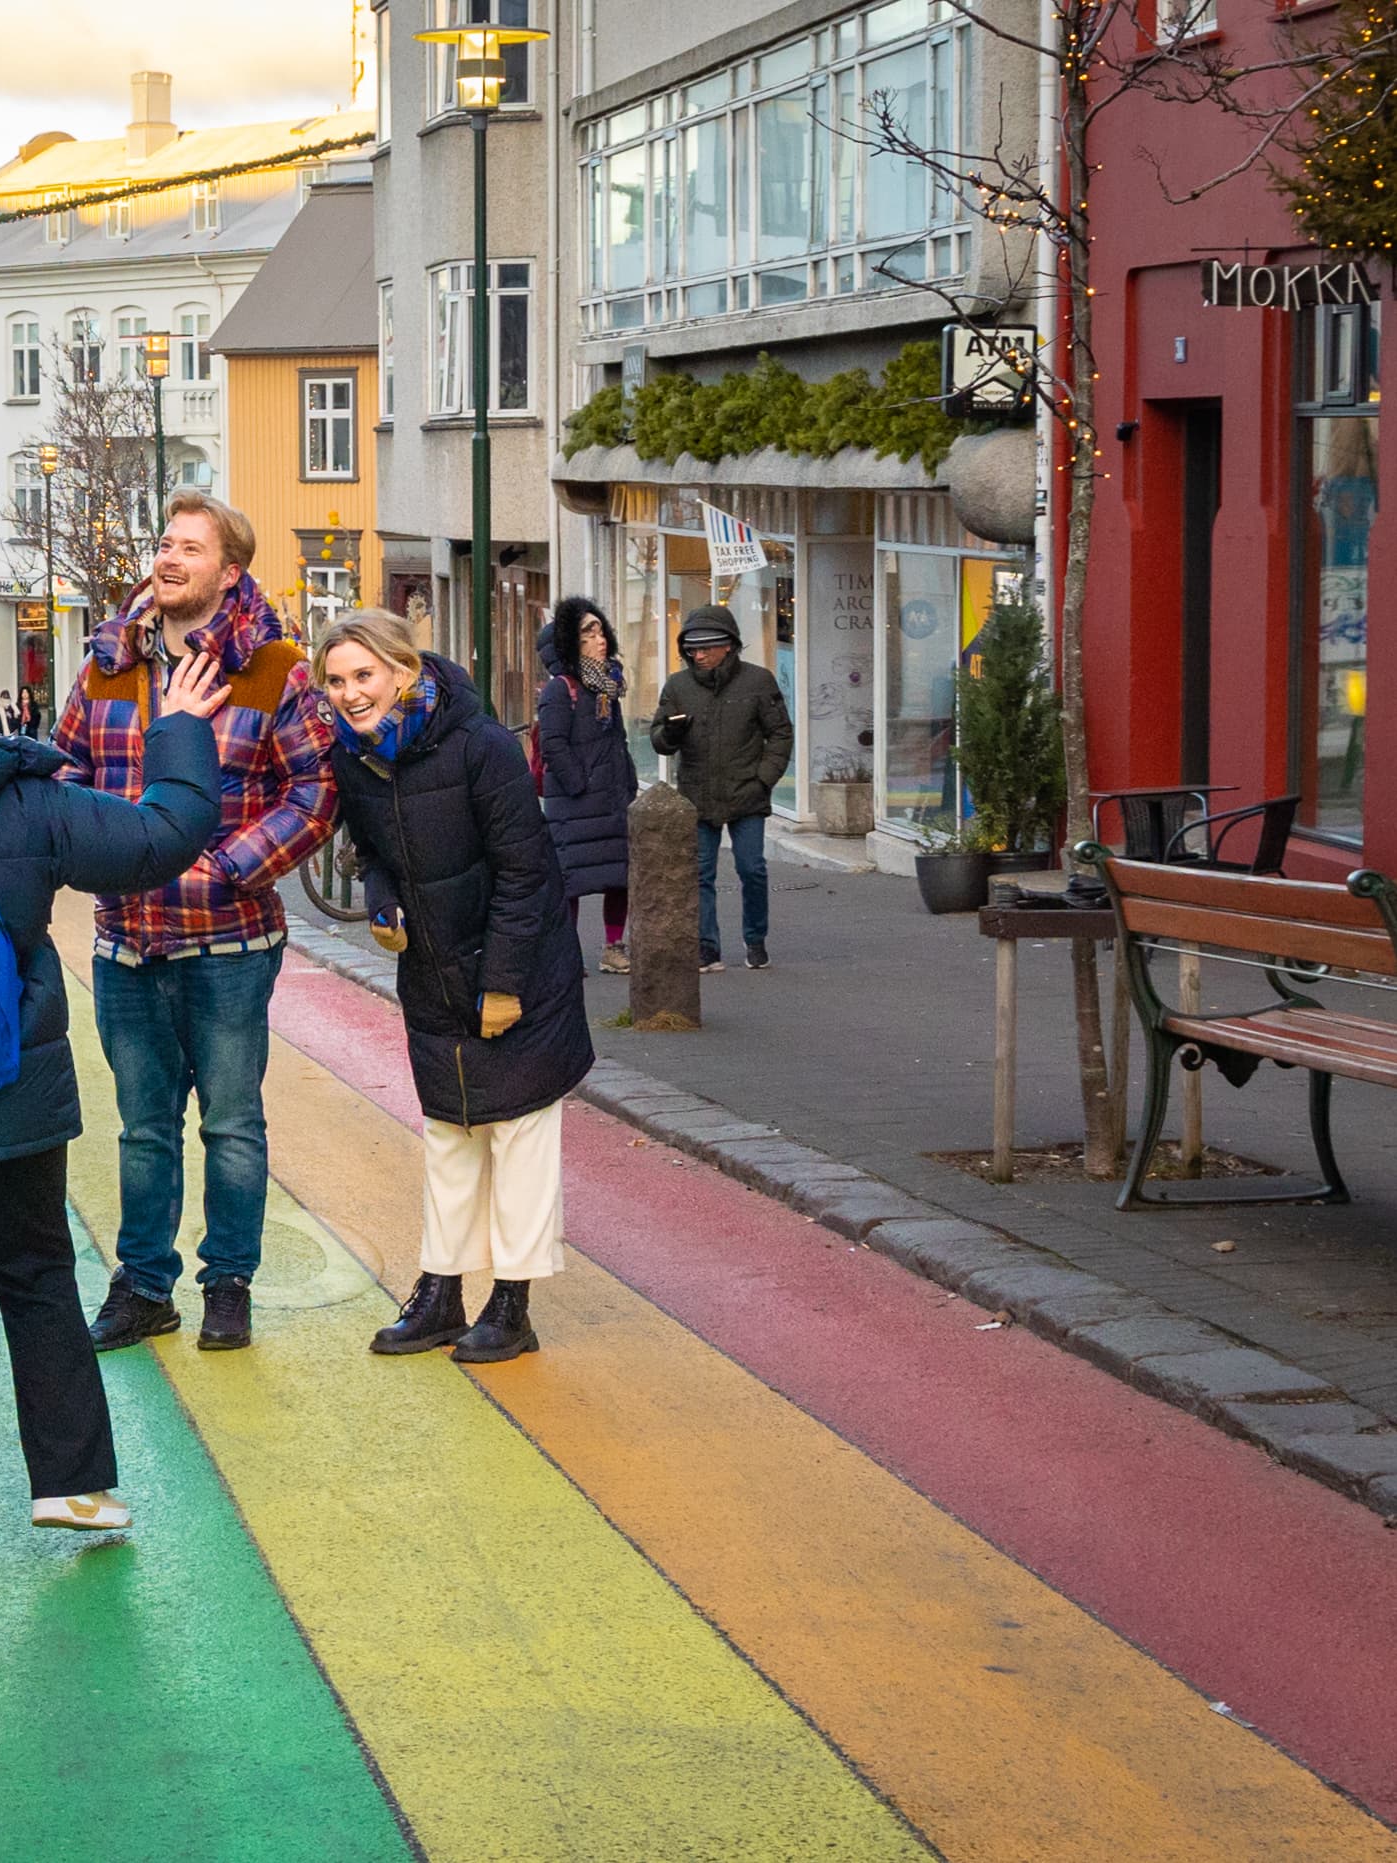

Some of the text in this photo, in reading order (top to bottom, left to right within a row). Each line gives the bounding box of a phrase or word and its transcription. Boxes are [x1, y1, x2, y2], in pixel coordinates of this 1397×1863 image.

[1212, 260, 1371, 311] MOKKA
[965, 335, 1026, 357] ATM
[714, 544, 757, 557] TAX FREE
[716, 554, 759, 568] SHOPPING
[834, 573, 874, 590] TIM
[833, 595, 874, 610] ARC
[833, 614, 874, 630] CRA
